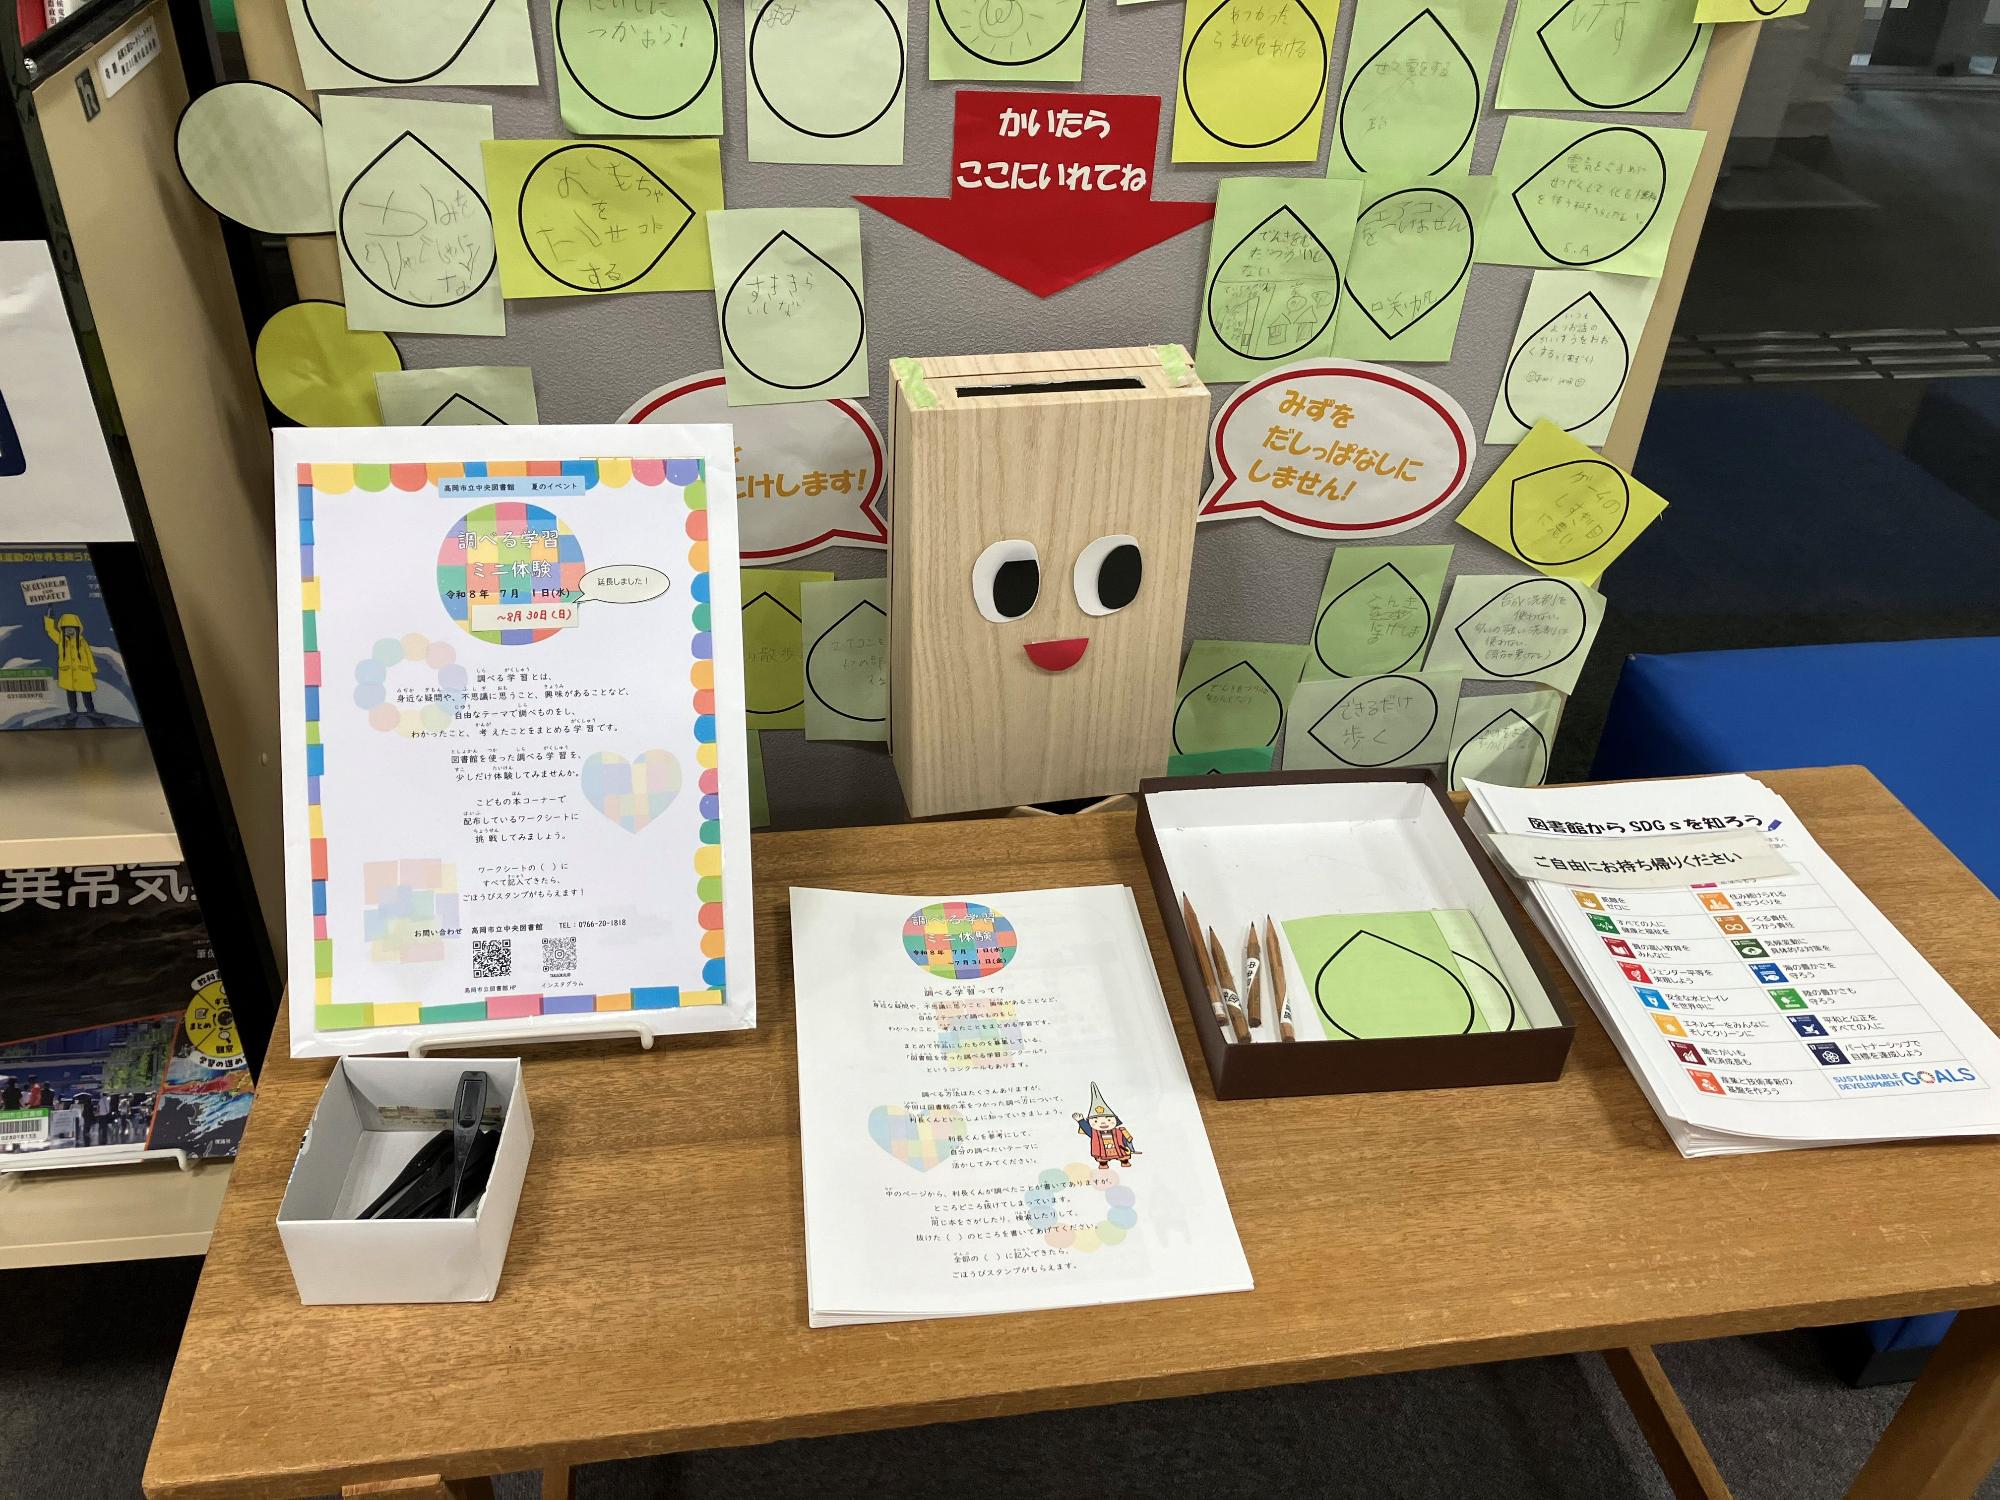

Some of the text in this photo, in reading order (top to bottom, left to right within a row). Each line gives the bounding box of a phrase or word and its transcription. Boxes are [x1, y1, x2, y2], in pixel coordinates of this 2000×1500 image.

[999, 108, 1111, 139] かいたら
[956, 160, 1147, 192] ここにいれてね
[1278, 388, 1356, 428] みずを
[1261, 424, 1425, 482] だしっぱなしに
[444, 482, 577, 492] 高岡市立中央図書館 夏のイベント
[1248, 458, 1358, 501] しません!
[457, 530, 559, 550] 調べる学習
[473, 560, 552, 578] ミニ体験
[477, 672, 553, 683] 調べる学習とは、
[1339, 696, 1413, 720] できるだけ
[1342, 726, 1388, 749] 歩く
[451, 751, 582, 764] 図書館を使った調べる学習を、
[456, 769, 580, 782] 少しだけ体験してみませんか。
[477, 795, 567, 806] こどもの本コーナーで
[463, 813, 580, 826] 配布しているワークシートに
[1533, 851, 1744, 874] ご自由にお持ち帰りください
[0, 865, 197, 912] 異常気
[483, 876, 561, 887] すべて記入できたら、
[414, 928, 463, 938] お問い合わせ
[471, 923, 544, 935] 高岡市立中央図書館
[199, 1055, 245, 1068] 学習の進め
[1833, 1072, 1901, 1083] SUSTAINABLE
[1839, 1067, 1977, 1091] DEVELOPMENT GOALS
